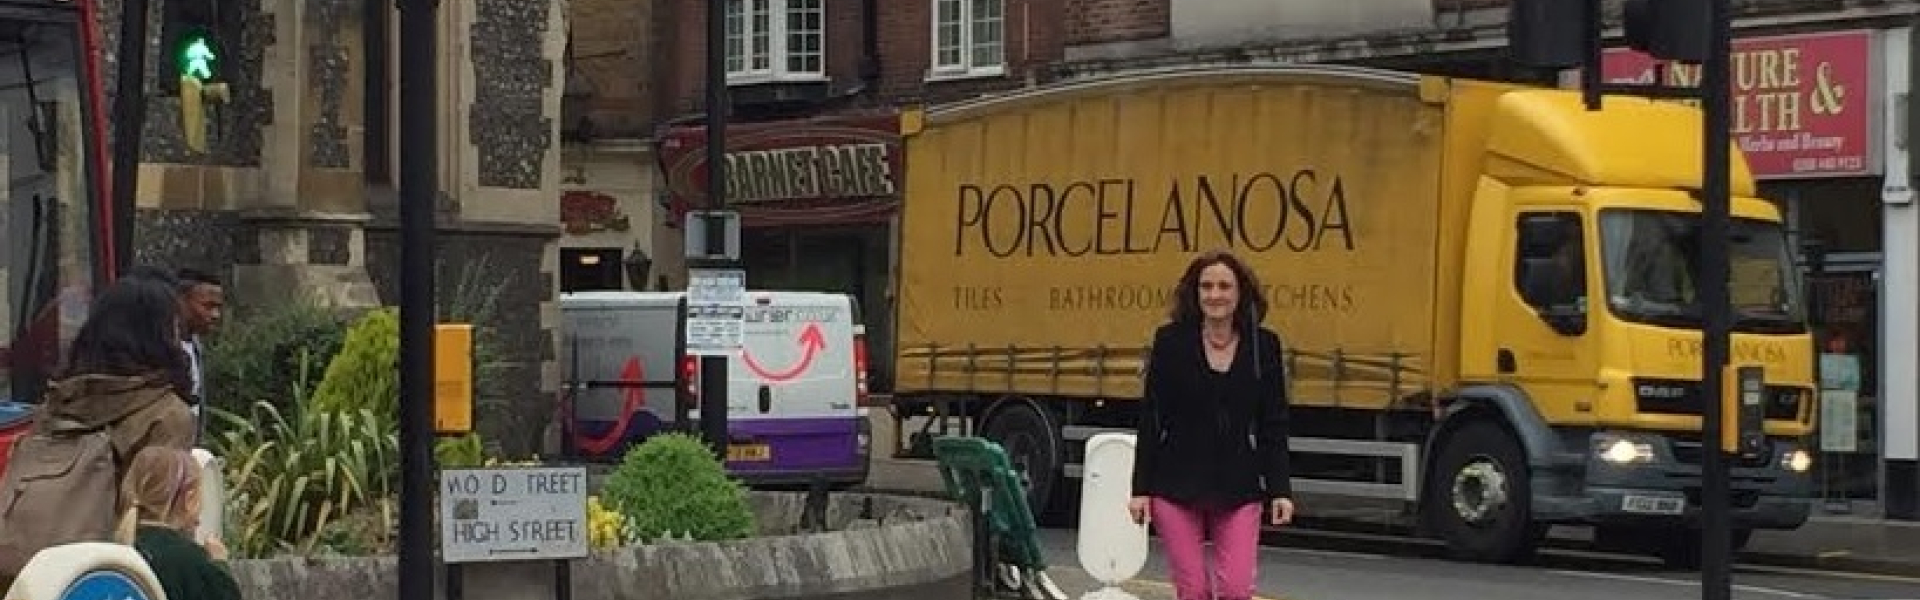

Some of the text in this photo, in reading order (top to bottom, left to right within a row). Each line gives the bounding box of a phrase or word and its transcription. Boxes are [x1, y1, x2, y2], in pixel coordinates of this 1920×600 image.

[1670, 47, 1800, 91] NURE
[1810, 61, 1845, 115] &
[724, 143, 894, 203] BARNET CAFE
[955, 169, 1355, 258] PORCELANOSA
[952, 284, 1353, 311] TILES BATHROOM TCHENS
[526, 471, 583, 495] TREET
[454, 518, 578, 544] HIGH STREET
